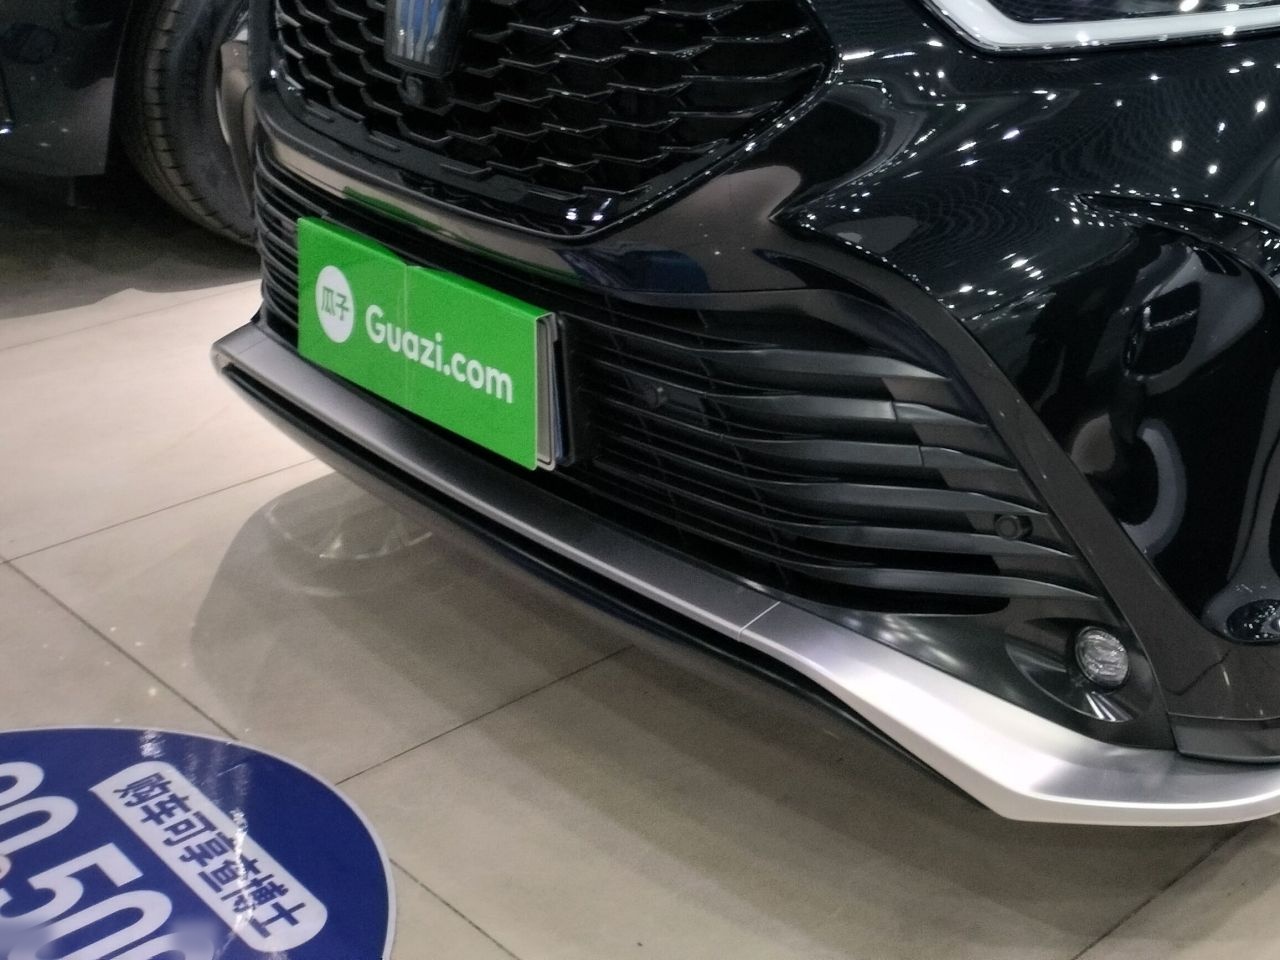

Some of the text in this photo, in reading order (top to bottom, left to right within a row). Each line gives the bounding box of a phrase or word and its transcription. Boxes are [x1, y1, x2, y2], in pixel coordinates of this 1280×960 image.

[321, 285, 350, 321] 瓜子
[365, 304, 513, 404] Guazi.com
[113, 771, 306, 939] 购车可享查博士
